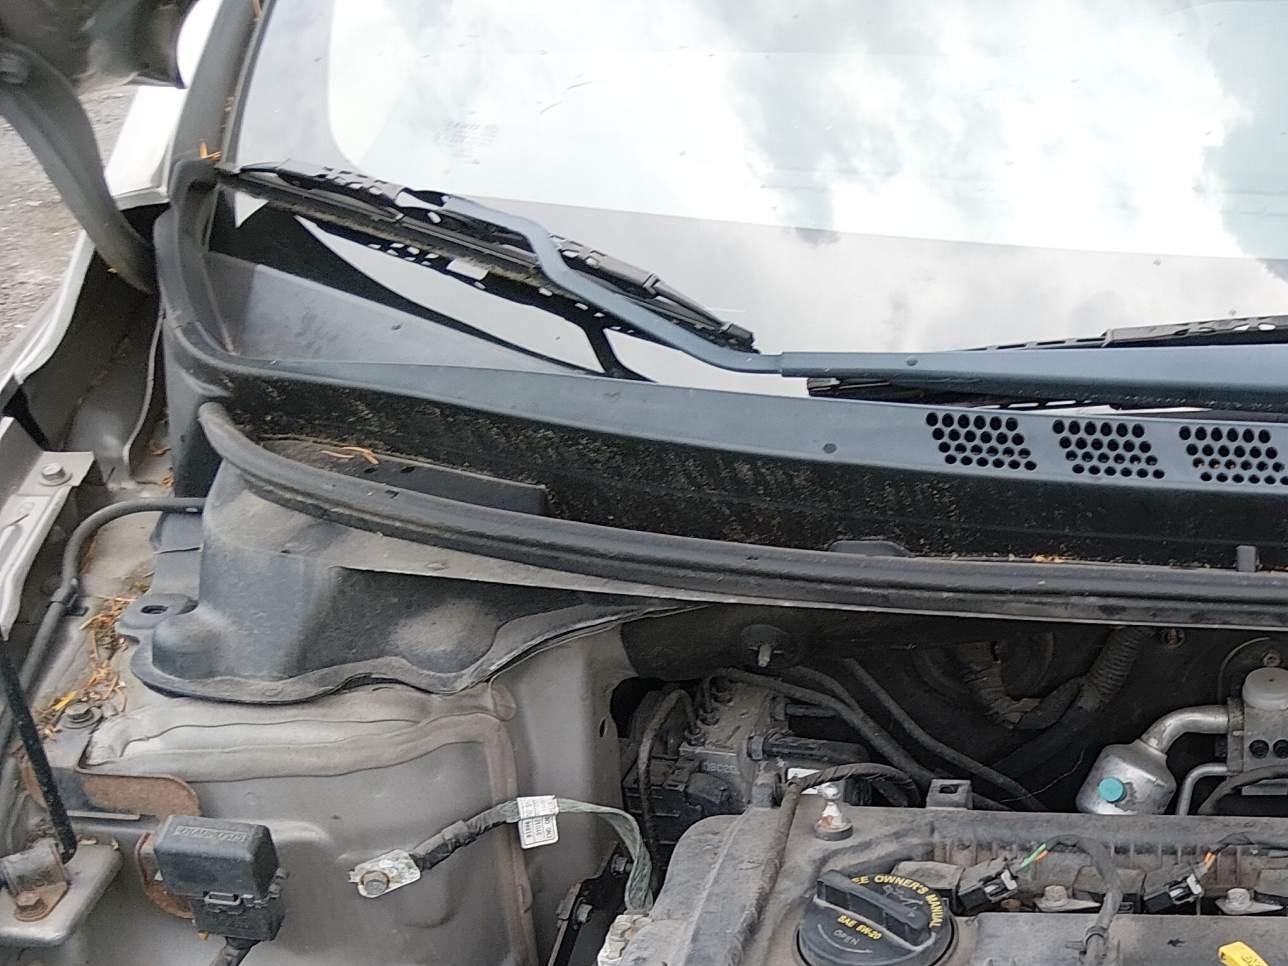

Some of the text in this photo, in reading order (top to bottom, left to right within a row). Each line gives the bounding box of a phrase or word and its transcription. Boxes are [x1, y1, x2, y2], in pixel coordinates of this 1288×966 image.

[874, 875, 929, 895] OWNER'S
[925, 893, 944, 928] MANUAL
[837, 914, 858, 928] SAE
